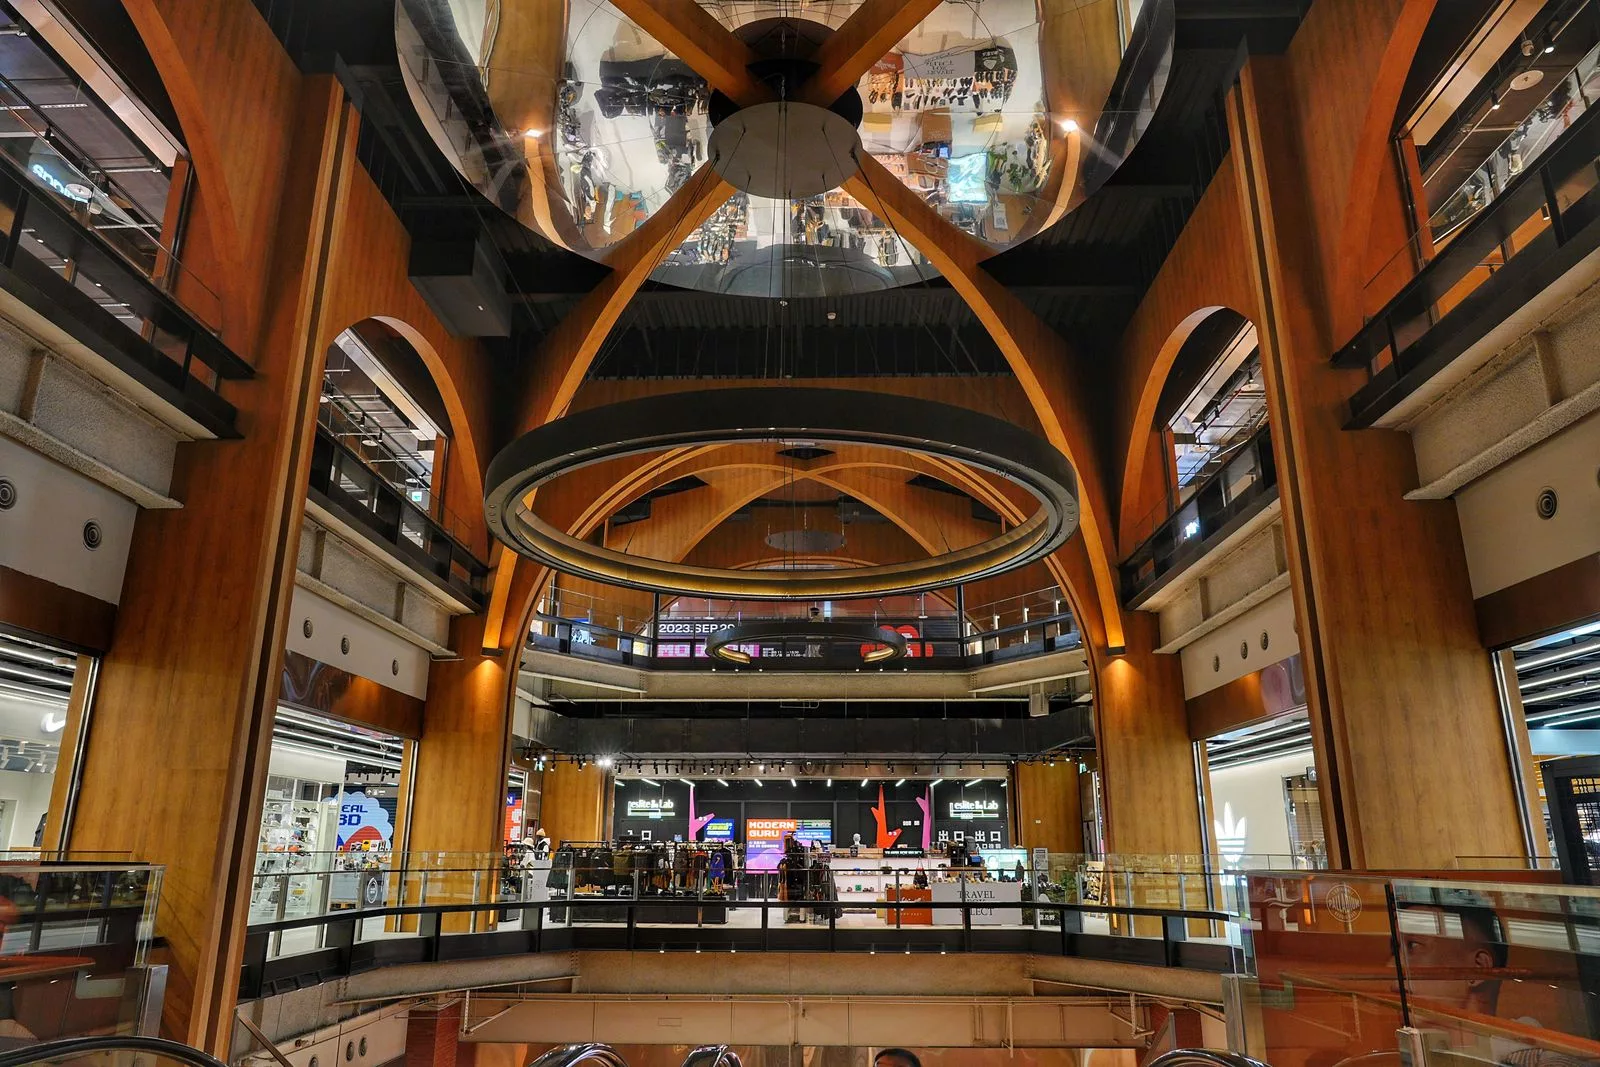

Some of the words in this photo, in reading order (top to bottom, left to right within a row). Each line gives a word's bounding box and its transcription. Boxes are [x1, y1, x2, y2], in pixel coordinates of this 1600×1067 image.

[659, 798, 674, 808] Lab
[983, 799, 999, 809] Lab
[342, 804, 368, 813] EAL
[748, 821, 795, 829] MODERN
[748, 829, 779, 837] GURU
[957, 890, 995, 899] TRAVEL
[959, 908, 993, 916] SLECT
